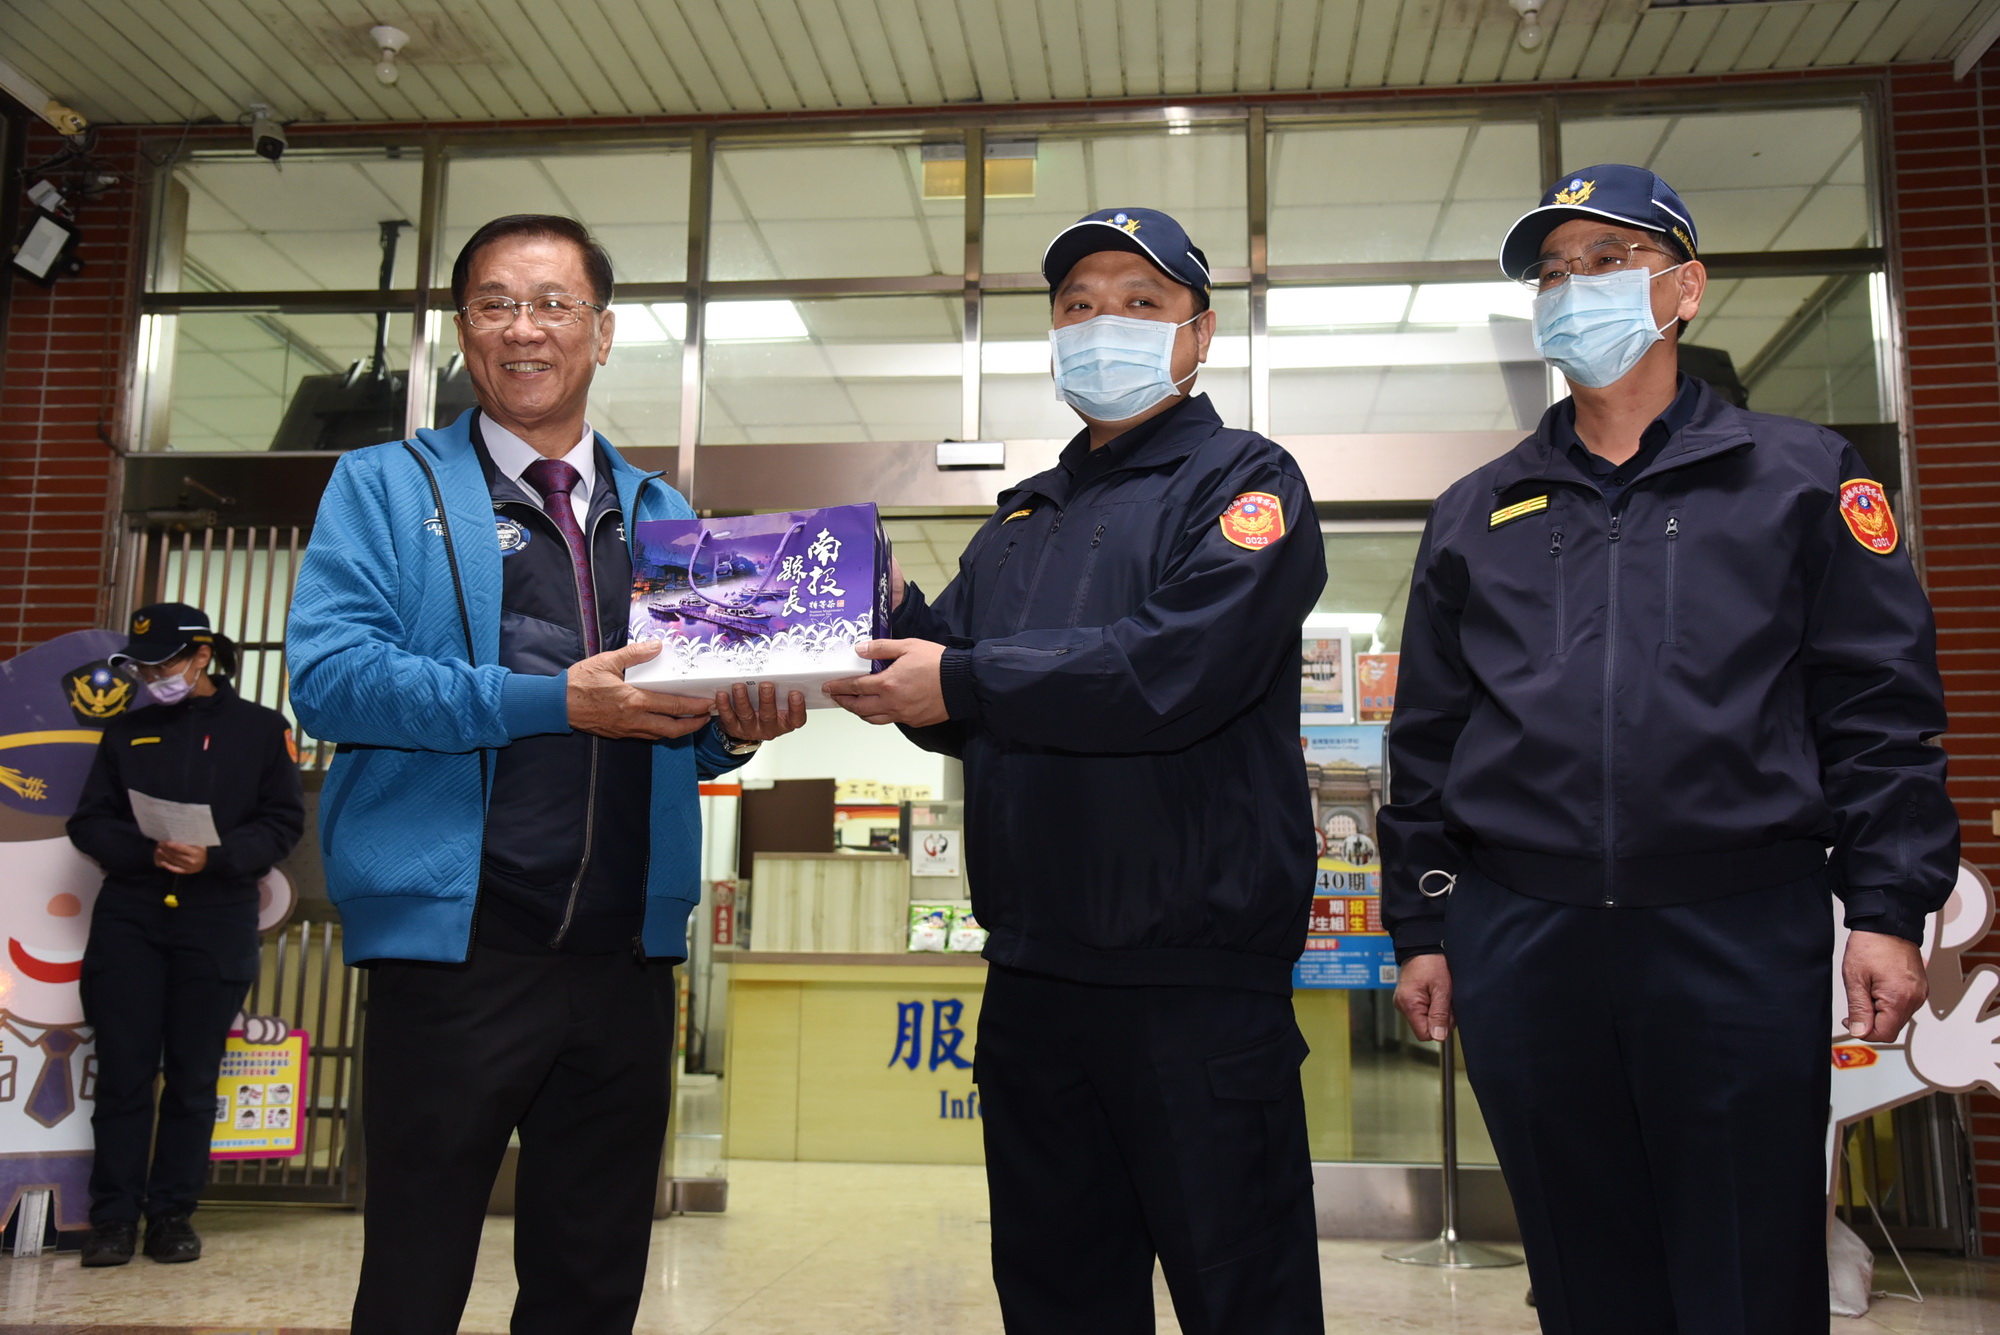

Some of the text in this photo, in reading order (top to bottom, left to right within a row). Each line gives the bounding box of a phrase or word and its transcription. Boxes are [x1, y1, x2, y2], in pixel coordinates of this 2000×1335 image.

[1245, 536, 1269, 544] 0023
[1872, 537, 1891, 548] 0001
[1317, 872, 1366, 891] 40期
[887, 998, 973, 1072] 服
